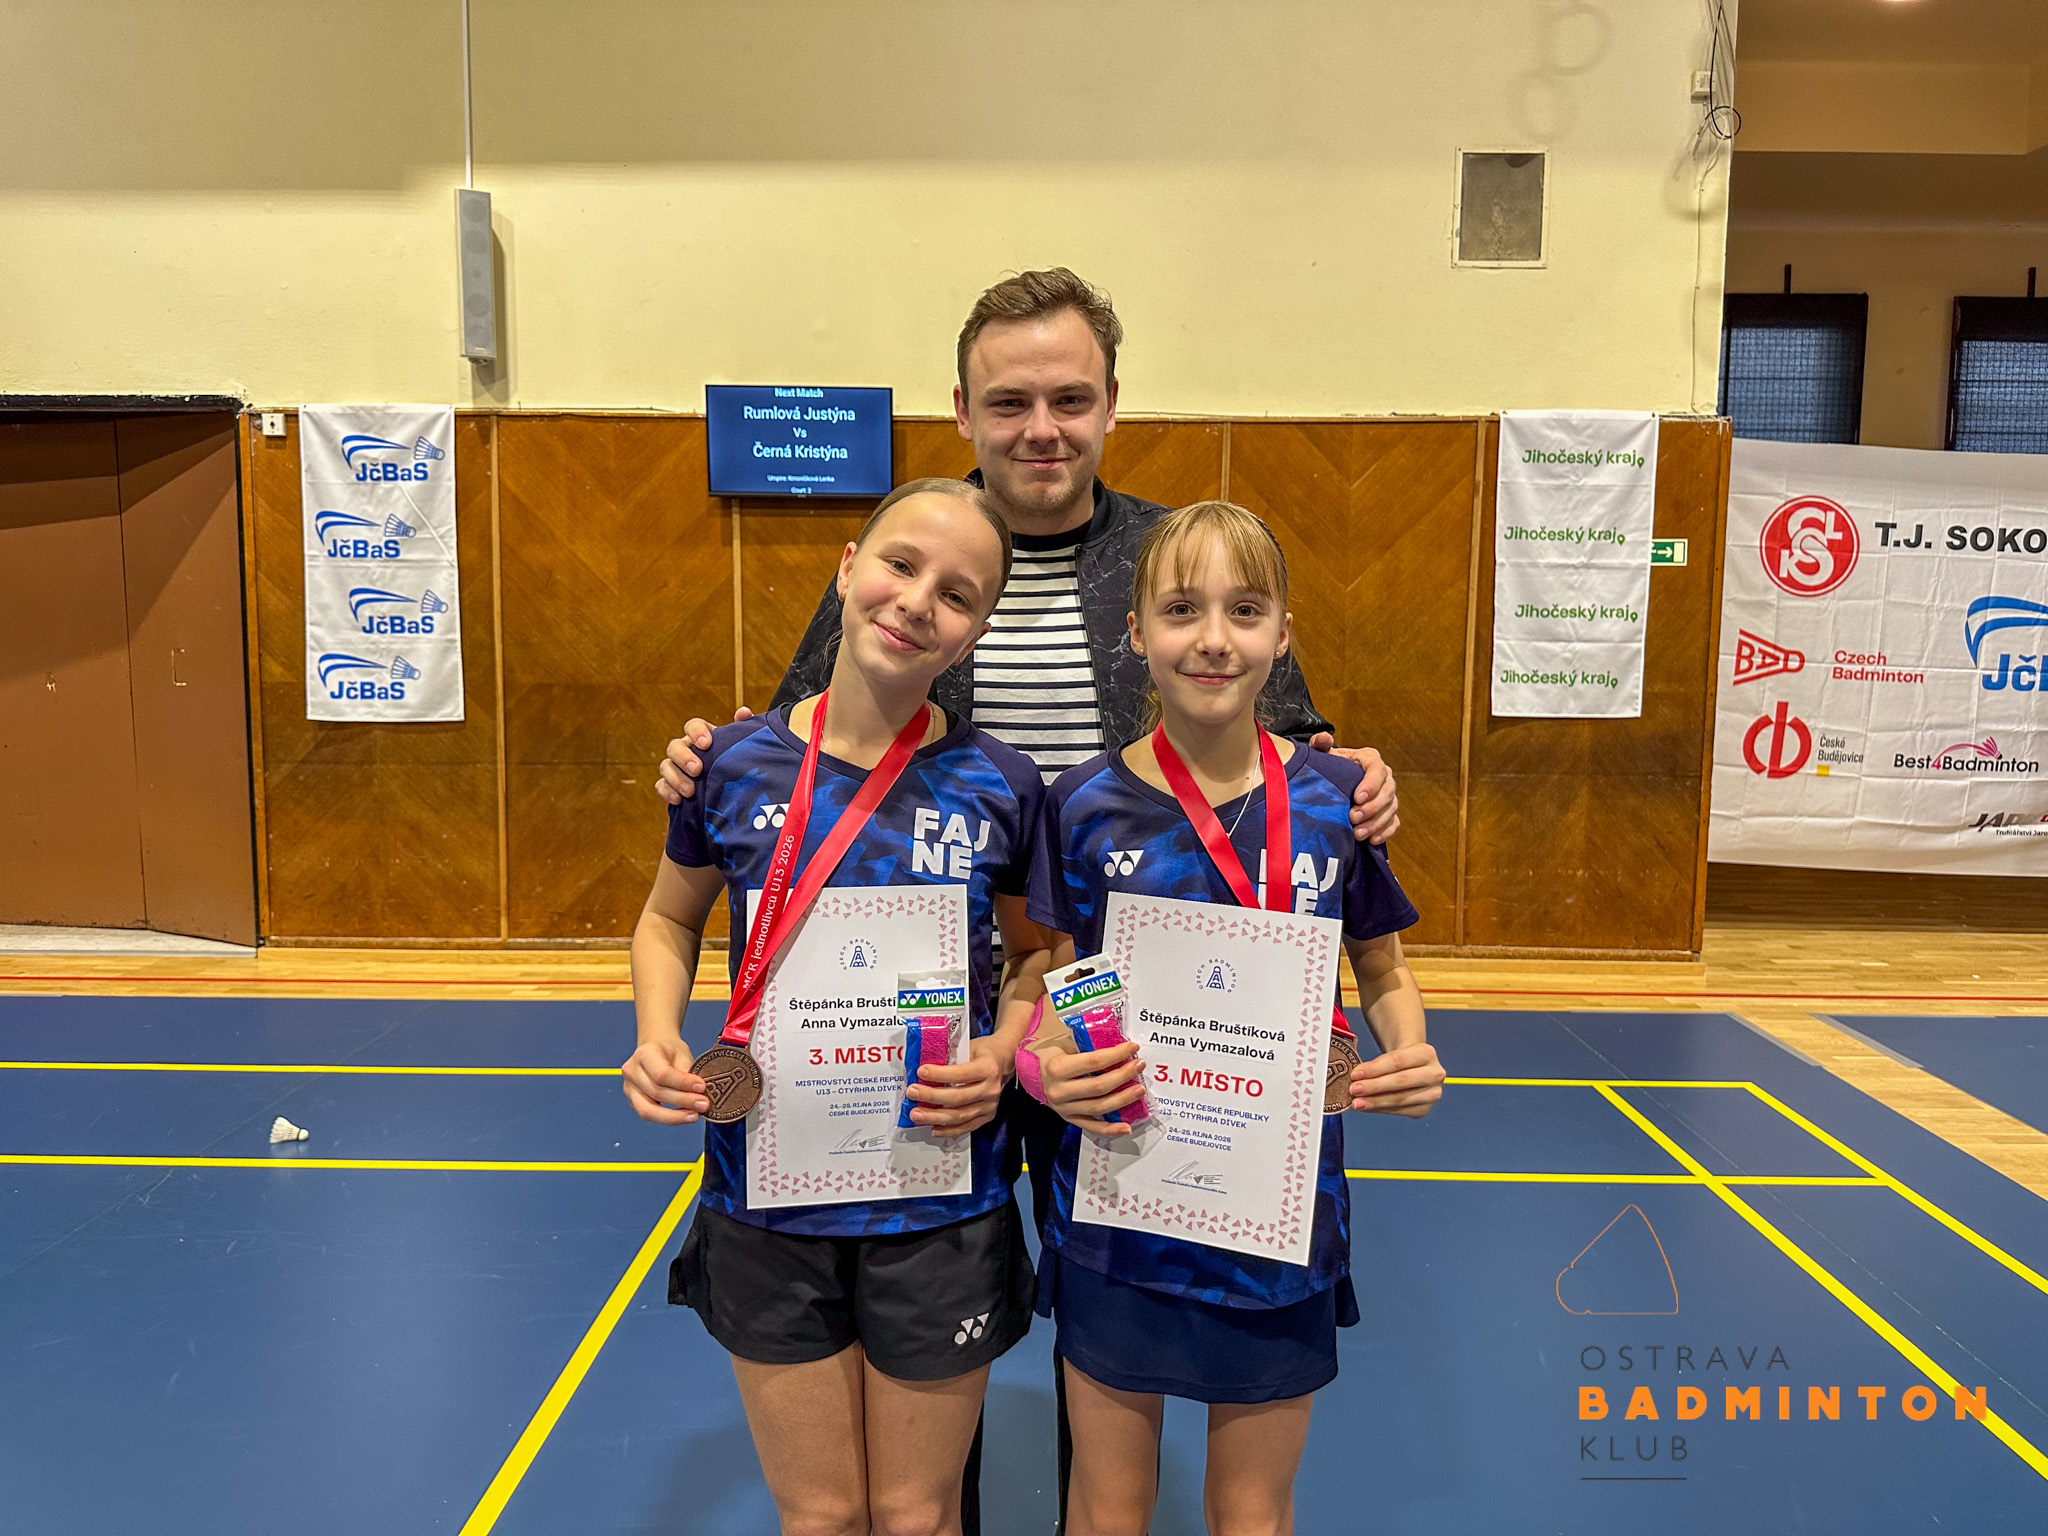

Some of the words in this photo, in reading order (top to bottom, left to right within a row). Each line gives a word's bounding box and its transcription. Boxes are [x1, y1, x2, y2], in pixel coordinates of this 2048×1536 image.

[774, 387, 795, 398] Next
[796, 388, 824, 398] Match
[744, 405, 800, 420] Rumlová
[803, 406, 856, 424] Justýna
[792, 427, 808, 438] Vs
[753, 441, 792, 458] Černá
[794, 445, 848, 462] Kristýna
[1522, 449, 1602, 468] Jihočeský
[1606, 450, 1636, 466] kraj
[356, 462, 428, 482] JčBaS
[1504, 526, 1584, 544] Jihočeský
[1588, 528, 1616, 544] kraj
[1875, 522, 1932, 548] T.J.
[1946, 526, 2048, 554] SOKO
[327, 539, 401, 559] JčBaS
[1514, 604, 1596, 622] Jihočeský
[1600, 605, 1629, 622] kraj
[362, 615, 434, 634] JčBaS
[1834, 650, 1886, 666] Czech
[1500, 669, 1578, 688] Jihočeský
[1581, 671, 1610, 688] kraj
[1832, 666, 1924, 684] Badminton
[330, 681, 405, 700] JčBaS
[1820, 733, 1846, 748] České
[1818, 749, 1864, 765] Budějovice
[1894, 754, 2039, 772] Best4Badminton
[914, 808, 991, 852] FAJ
[912, 840, 972, 880] NE
[1258, 848, 1339, 892] AJ
[750, 895, 778, 960] jednotlivců
[770, 868, 784, 892] U13
[778, 835, 795, 866] 2026
[1258, 884, 1318, 916] E
[1076, 975, 1116, 998] YONEX
[789, 998, 853, 1012] Štěpánka
[924, 990, 960, 1004] YONEX
[801, 1018, 836, 1028] Anna
[1139, 1008, 1206, 1030] Štěpánka
[1209, 1020, 1286, 1042] Bruštíková
[1150, 1032, 1186, 1046] Anna
[1190, 1037, 1275, 1060] Vymazalová
[809, 1049, 828, 1065] 3.
[1154, 1064, 1174, 1084] 3.
[1180, 1068, 1264, 1098] MÍSTO
[816, 1088, 830, 1096] U13
[1224, 1108, 1270, 1122] REPUBLIKY
